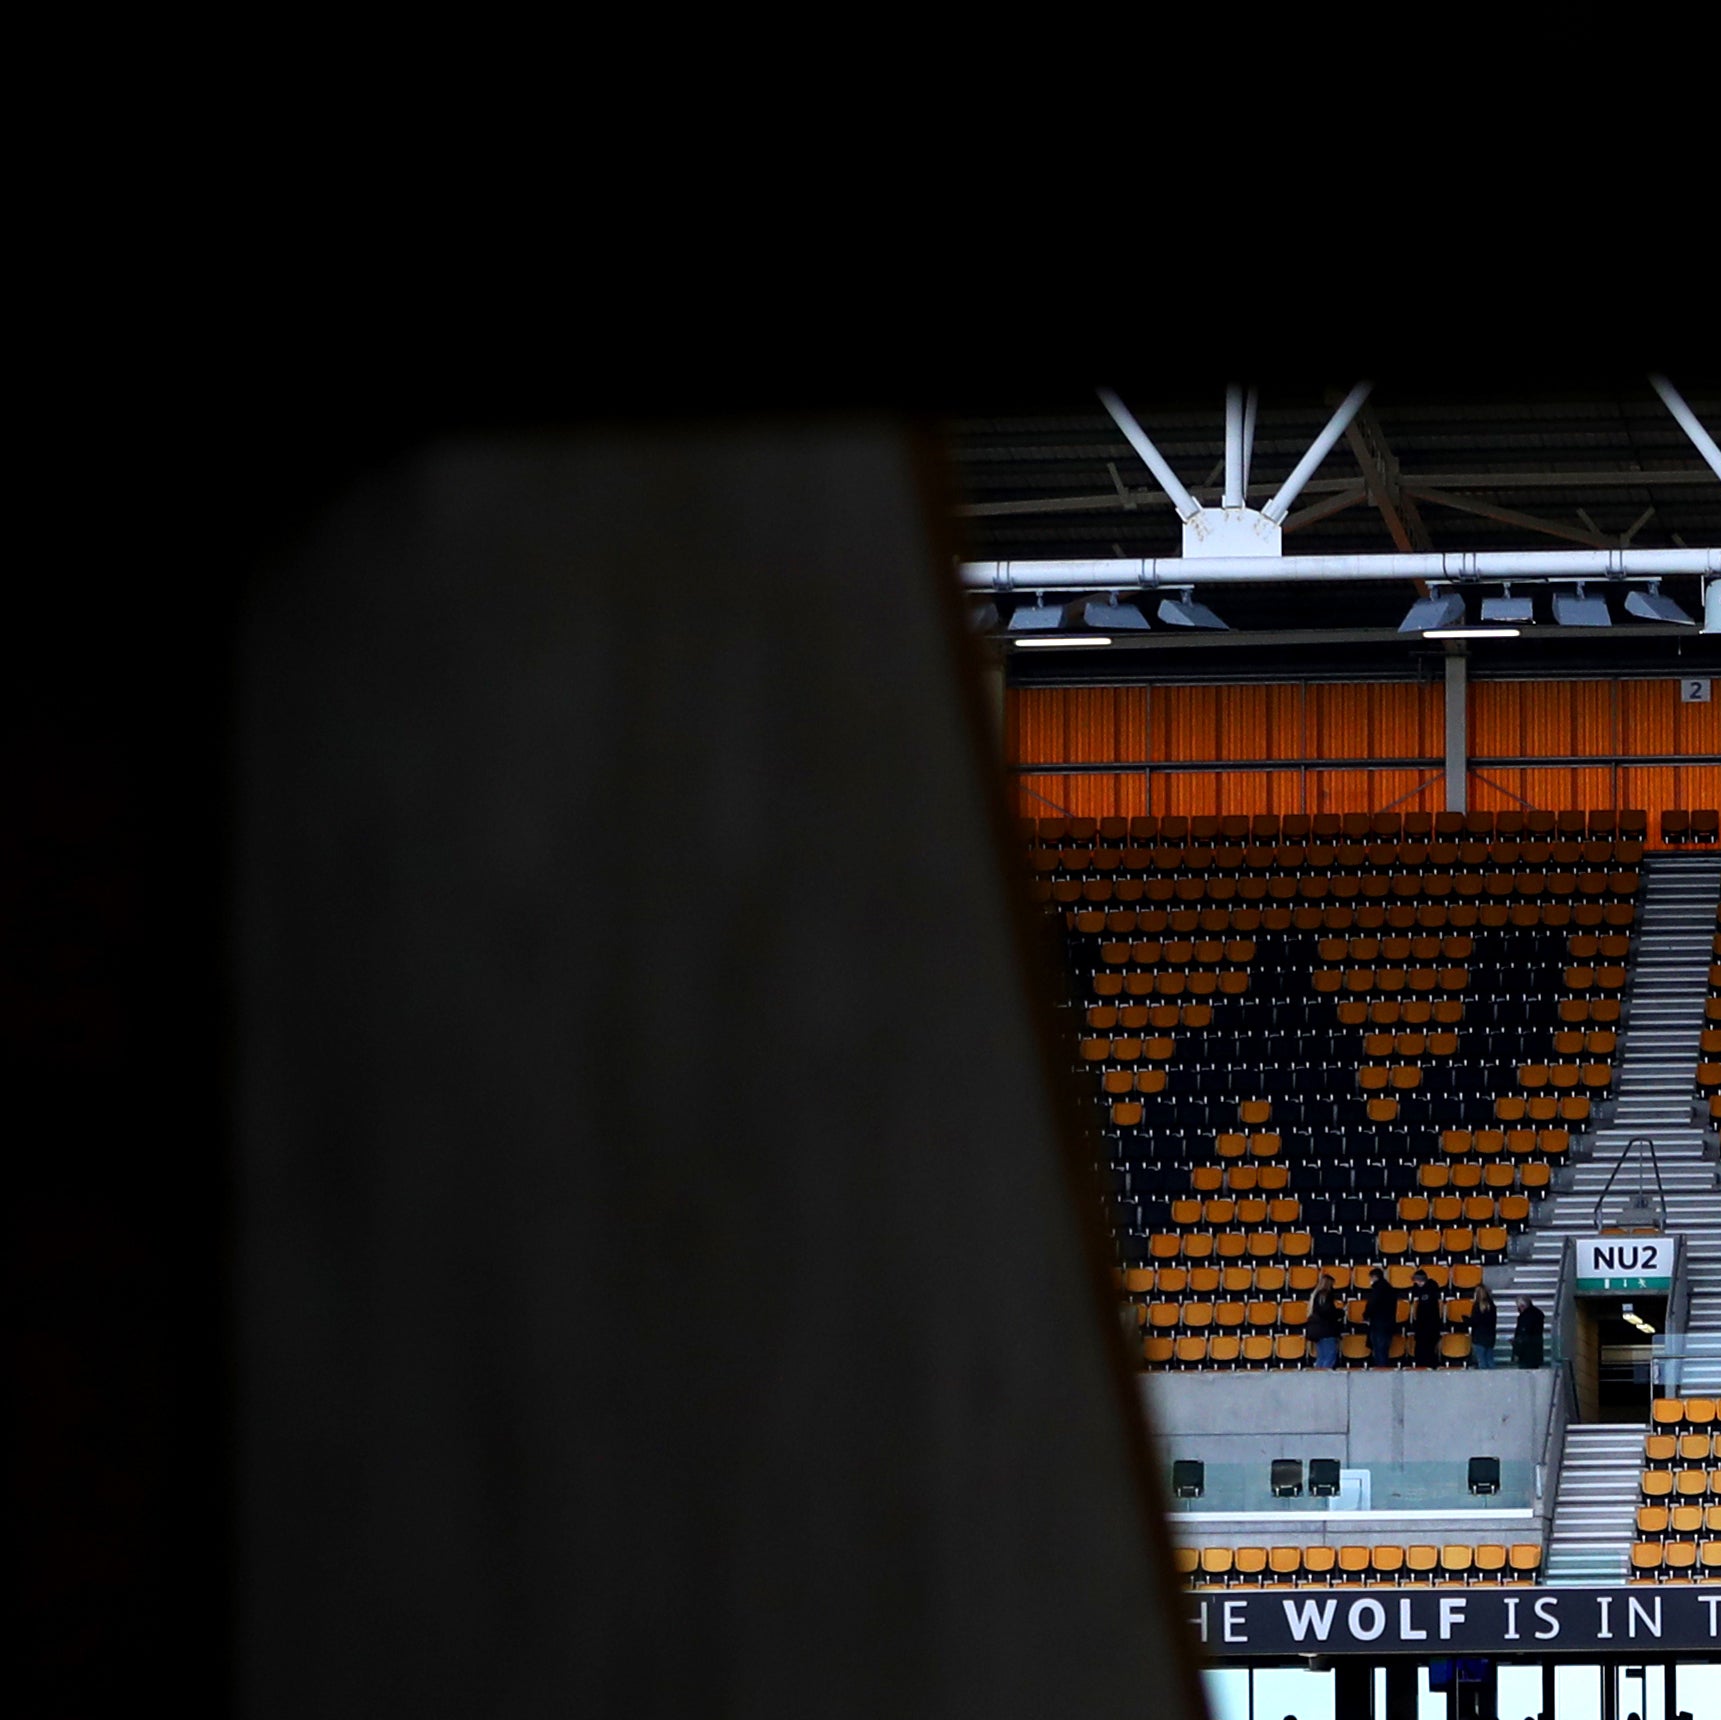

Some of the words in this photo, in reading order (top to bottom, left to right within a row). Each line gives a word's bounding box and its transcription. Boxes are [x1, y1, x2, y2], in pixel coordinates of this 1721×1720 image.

[1689, 681, 1702, 699] 2
[1593, 1245, 1658, 1270] NU2
[1282, 1597, 1467, 1642] WOLF
[1503, 1596, 1561, 1640] IS
[1596, 1596, 1662, 1638] IN
